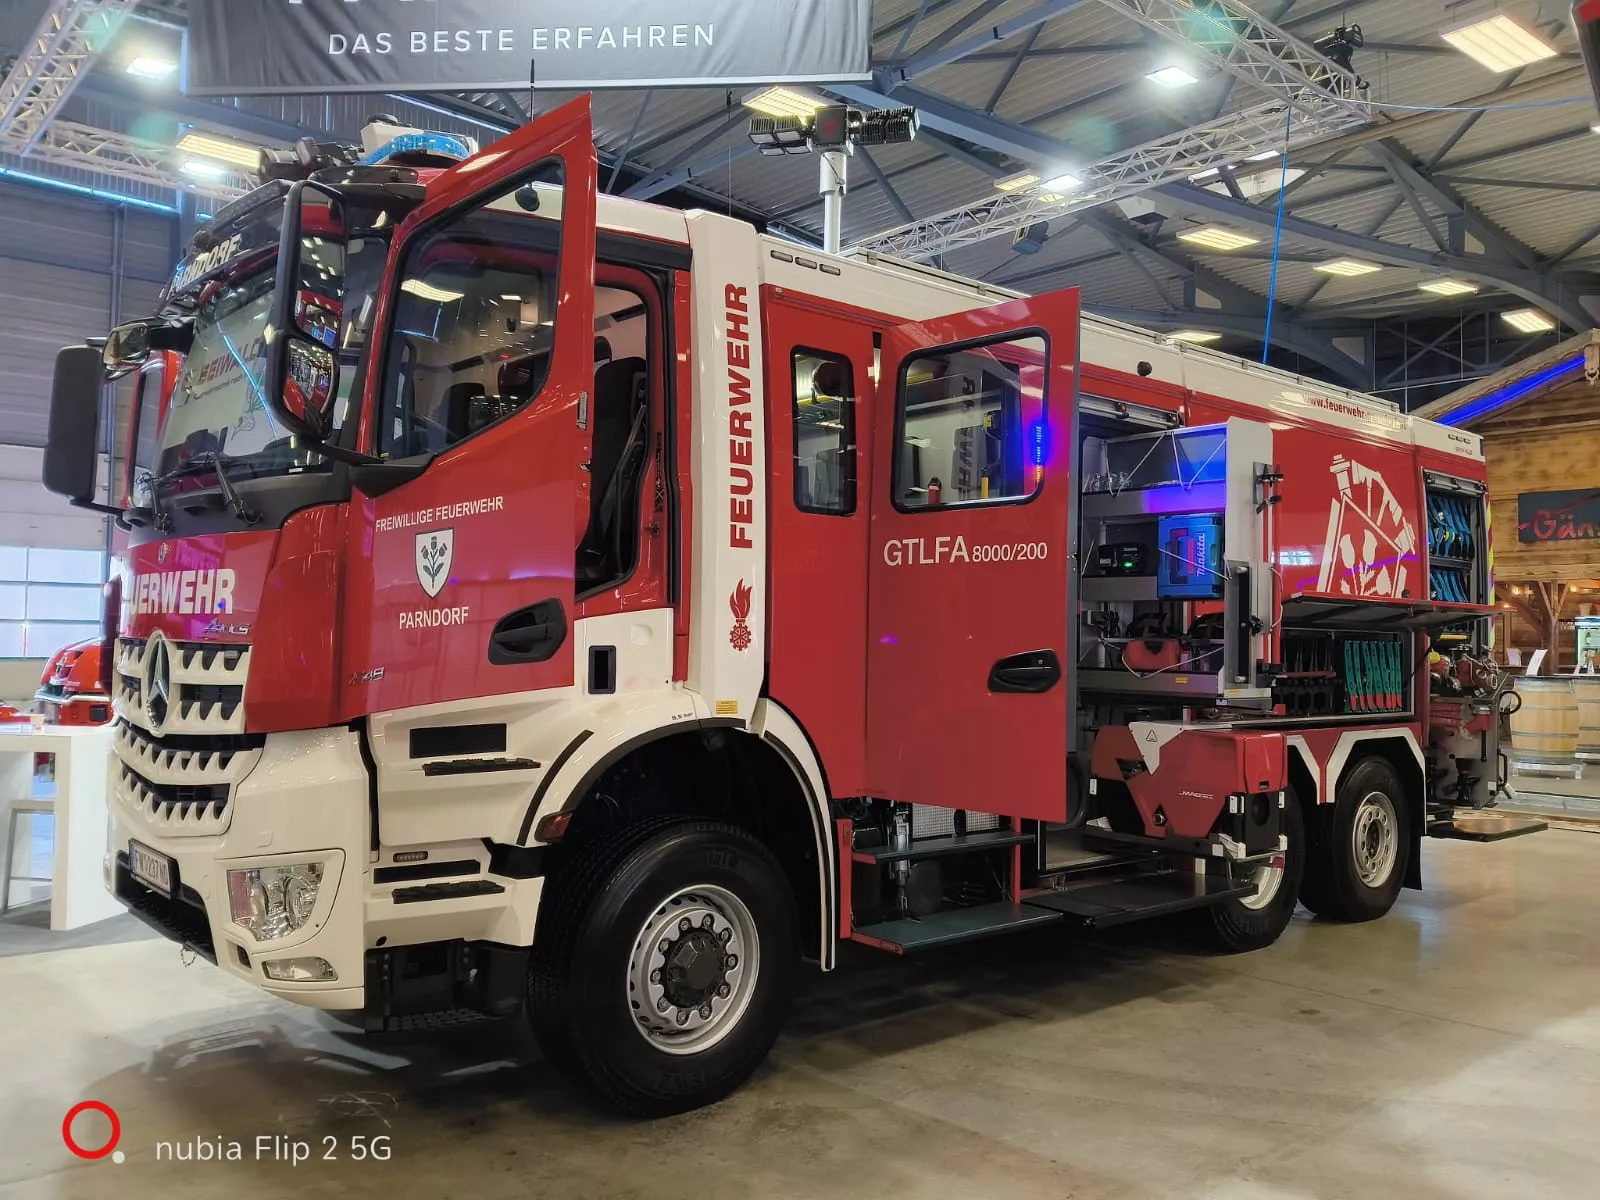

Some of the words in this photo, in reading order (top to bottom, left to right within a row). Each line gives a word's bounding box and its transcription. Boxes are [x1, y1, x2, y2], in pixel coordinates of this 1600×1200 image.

[328, 32, 392, 55] DAS
[410, 29, 515, 54] BESTE
[531, 23, 715, 51] ERFAHREN
[724, 282, 754, 549] FEUERWEHR
[375, 508, 433, 533] FREIWILLIGE
[435, 495, 504, 522] FEUERWEHR
[1532, 508, 1600, 540] Gän
[883, 535, 970, 567] GTLFA
[972, 542, 1048, 563] 8000/200
[130, 568, 237, 616] UERWEHR
[399, 606, 470, 630] PARNDORF
